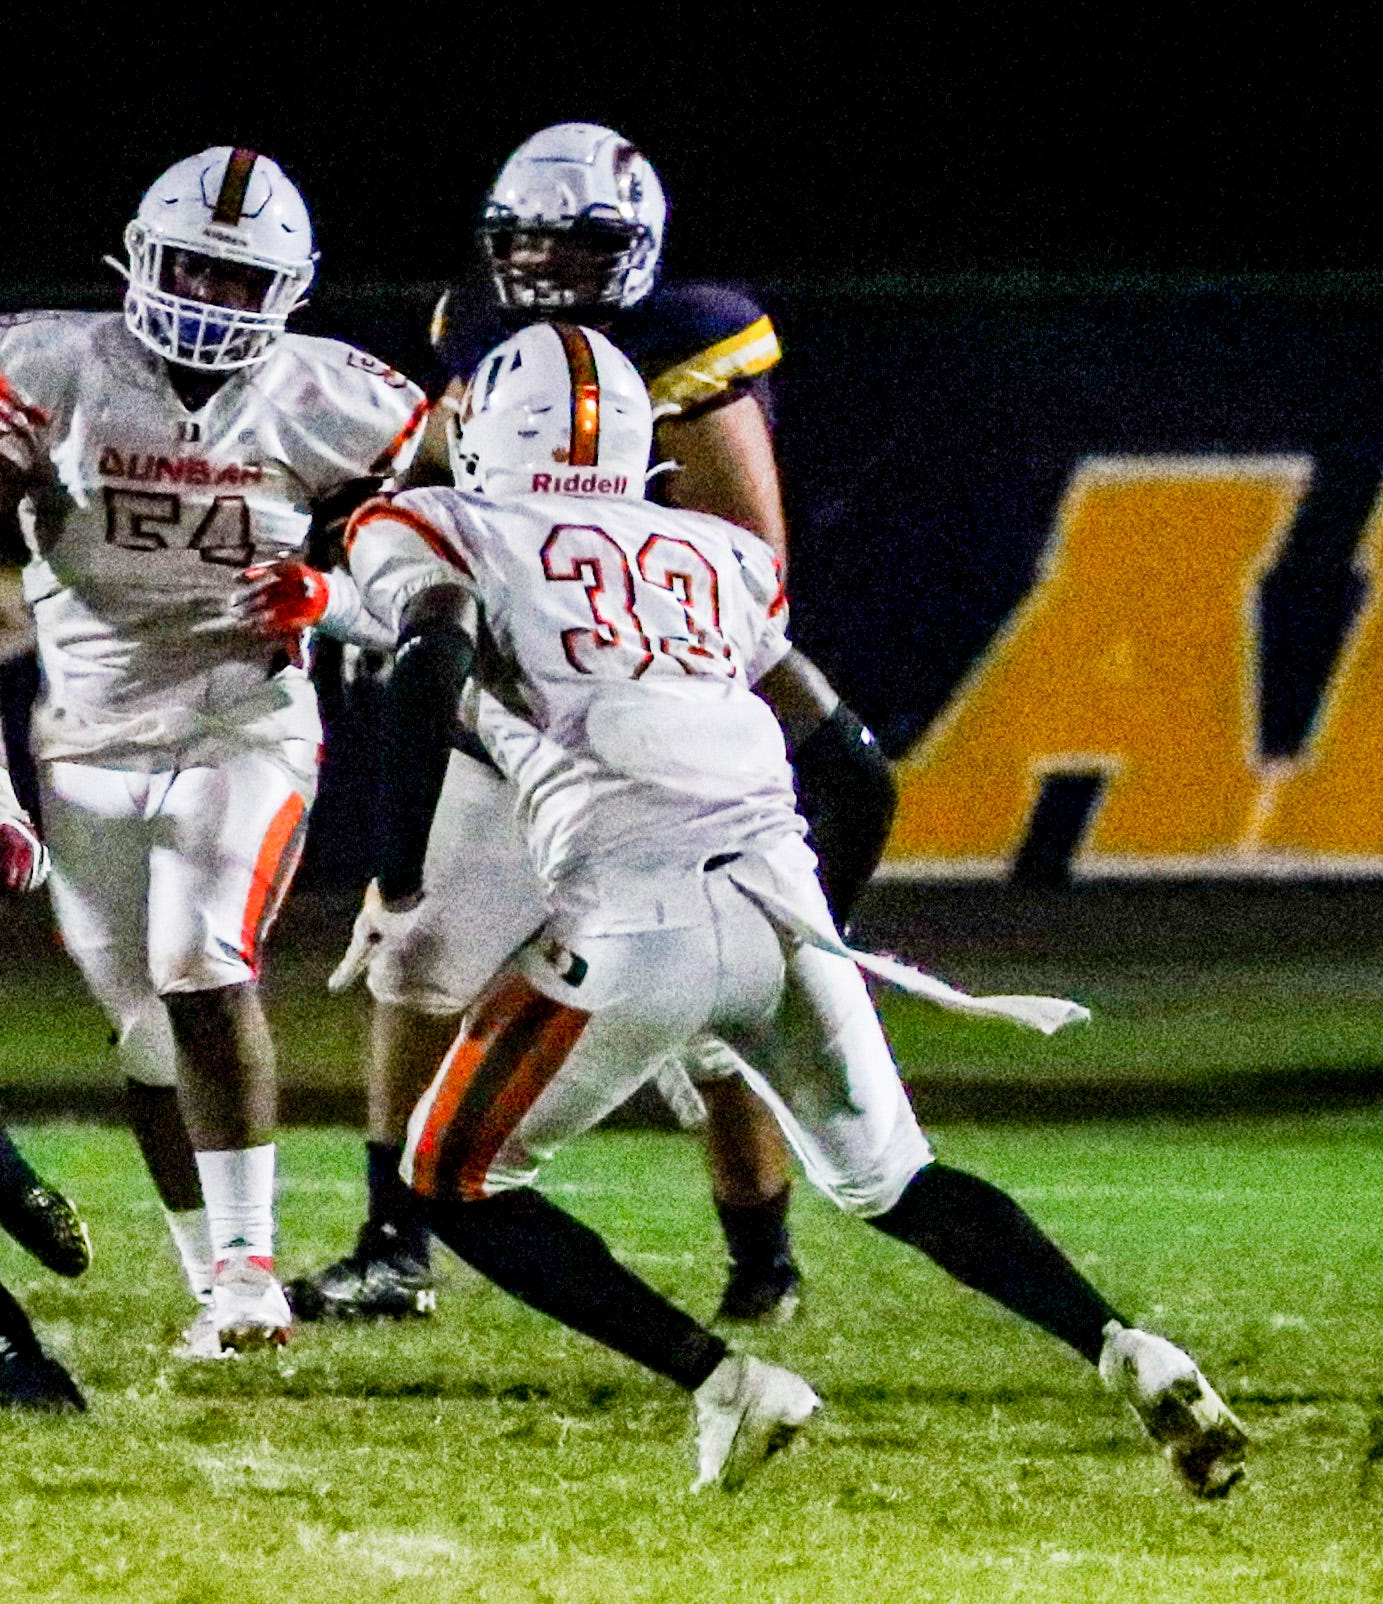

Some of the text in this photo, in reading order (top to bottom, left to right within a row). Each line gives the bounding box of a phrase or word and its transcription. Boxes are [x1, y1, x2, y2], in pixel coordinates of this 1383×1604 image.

[531, 472, 628, 495] Riddell
[103, 485, 256, 568] 54
[539, 523, 738, 680] 33
